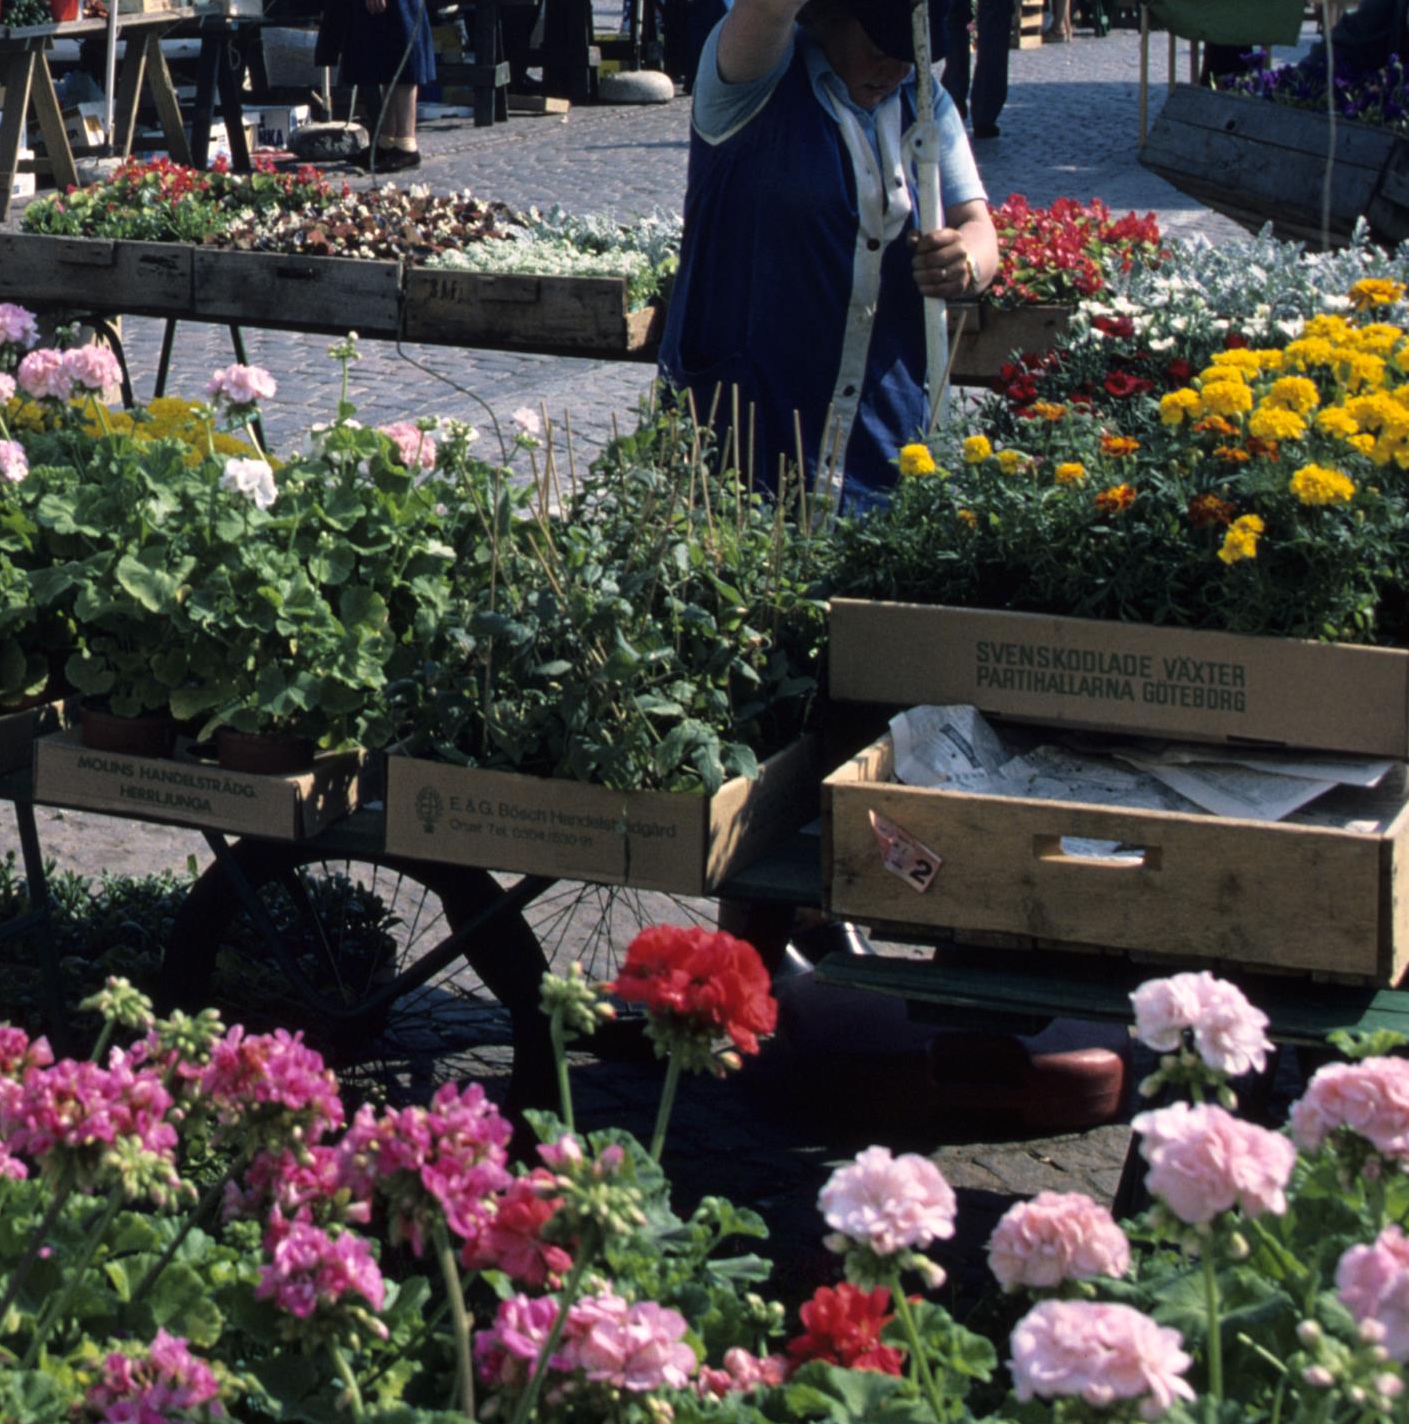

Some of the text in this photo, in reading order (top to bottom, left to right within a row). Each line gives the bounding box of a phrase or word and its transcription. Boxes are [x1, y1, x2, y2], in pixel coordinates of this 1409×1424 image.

[975, 640, 1246, 688] SVENSKODLADE VÄXTER
[975, 665, 1246, 712] PARTIHALLARNA GÖTEBORG
[78, 756, 134, 778] MOLINS
[119, 784, 212, 812] HERRLJUNGA
[498, 802, 547, 824] Bösch
[910, 859, 932, 885] 2
